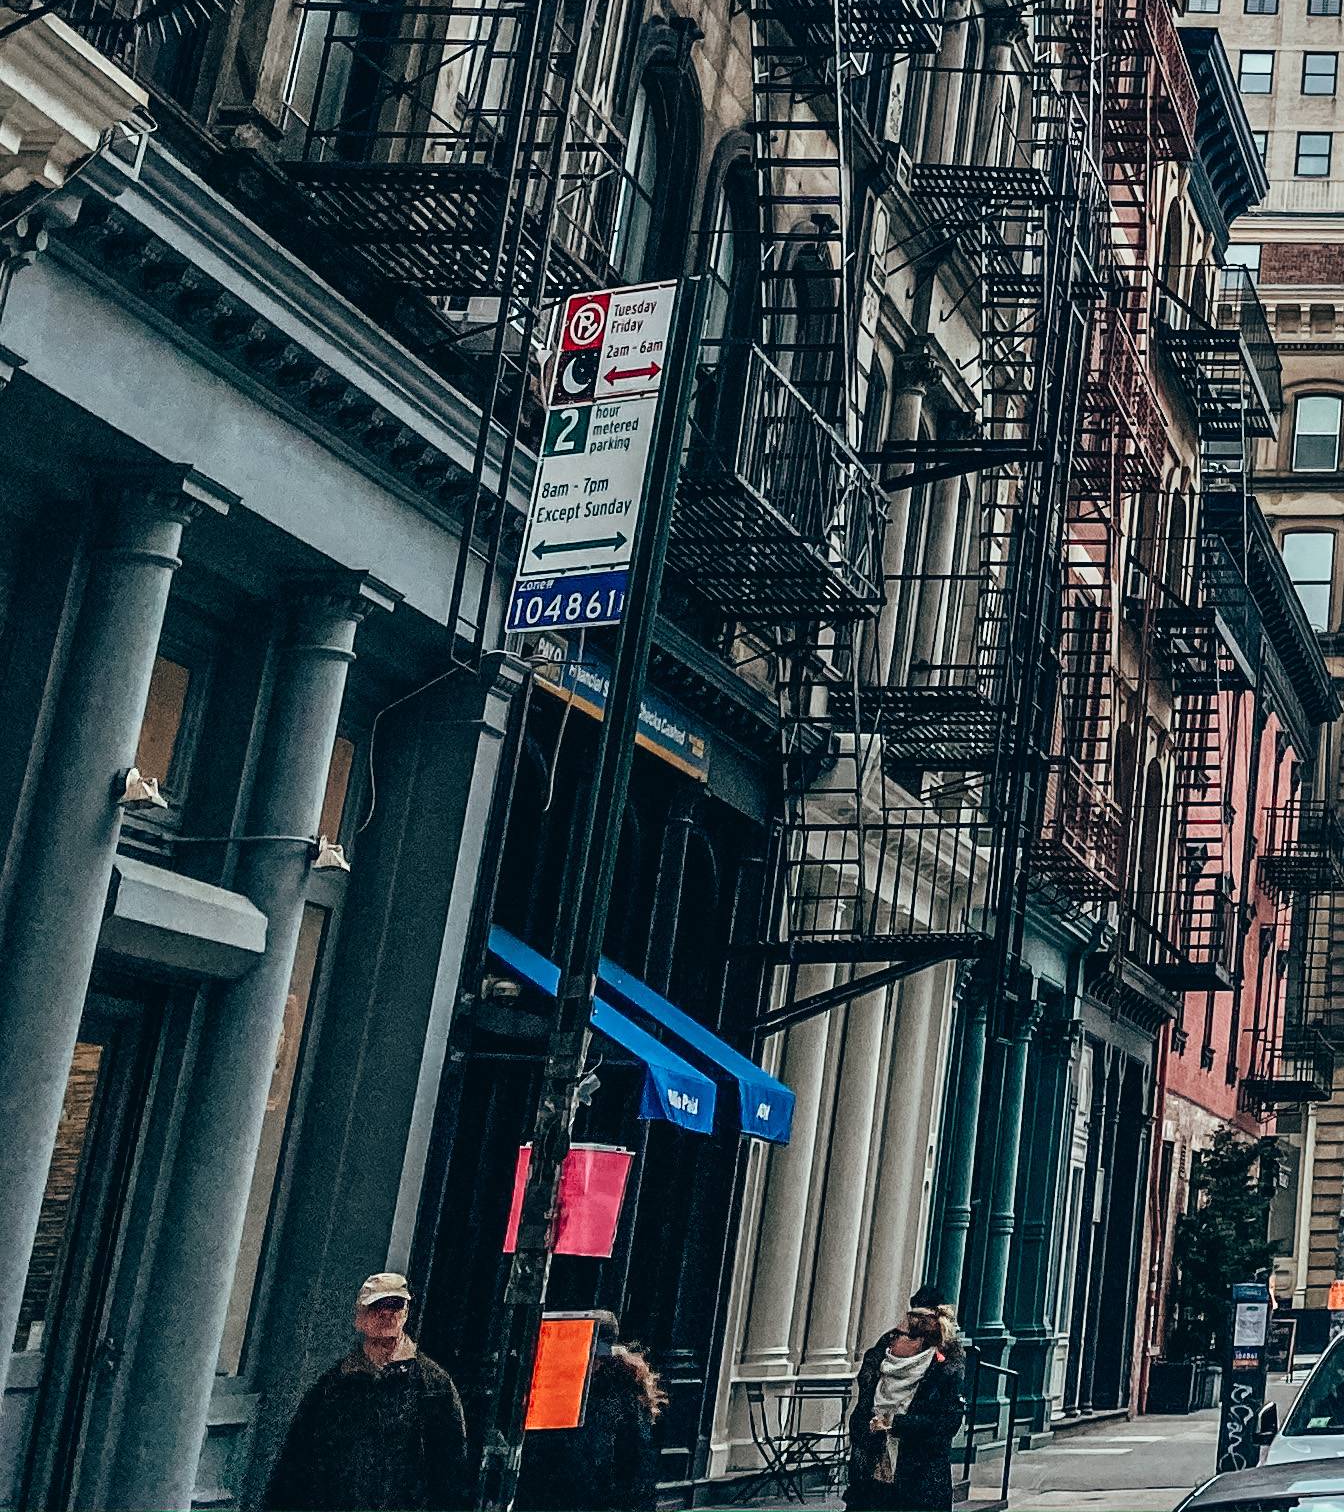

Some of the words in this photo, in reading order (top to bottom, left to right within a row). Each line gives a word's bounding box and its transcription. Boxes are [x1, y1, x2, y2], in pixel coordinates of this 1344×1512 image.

[613, 299, 658, 318] Tuesday
[610, 318, 645, 334] Friday
[606, 343, 630, 359] 2am
[639, 339, 663, 355] 6am
[595, 405, 621, 419] hour
[554, 409, 579, 452] 2
[592, 418, 639, 436] metered
[589, 435, 631, 454] parking
[541, 481, 570, 498] 8am
[583, 477, 609, 496] 7pm
[536, 503, 581, 524] Except
[584, 497, 633, 519] Sunday
[513, 590, 616, 626] 104861
